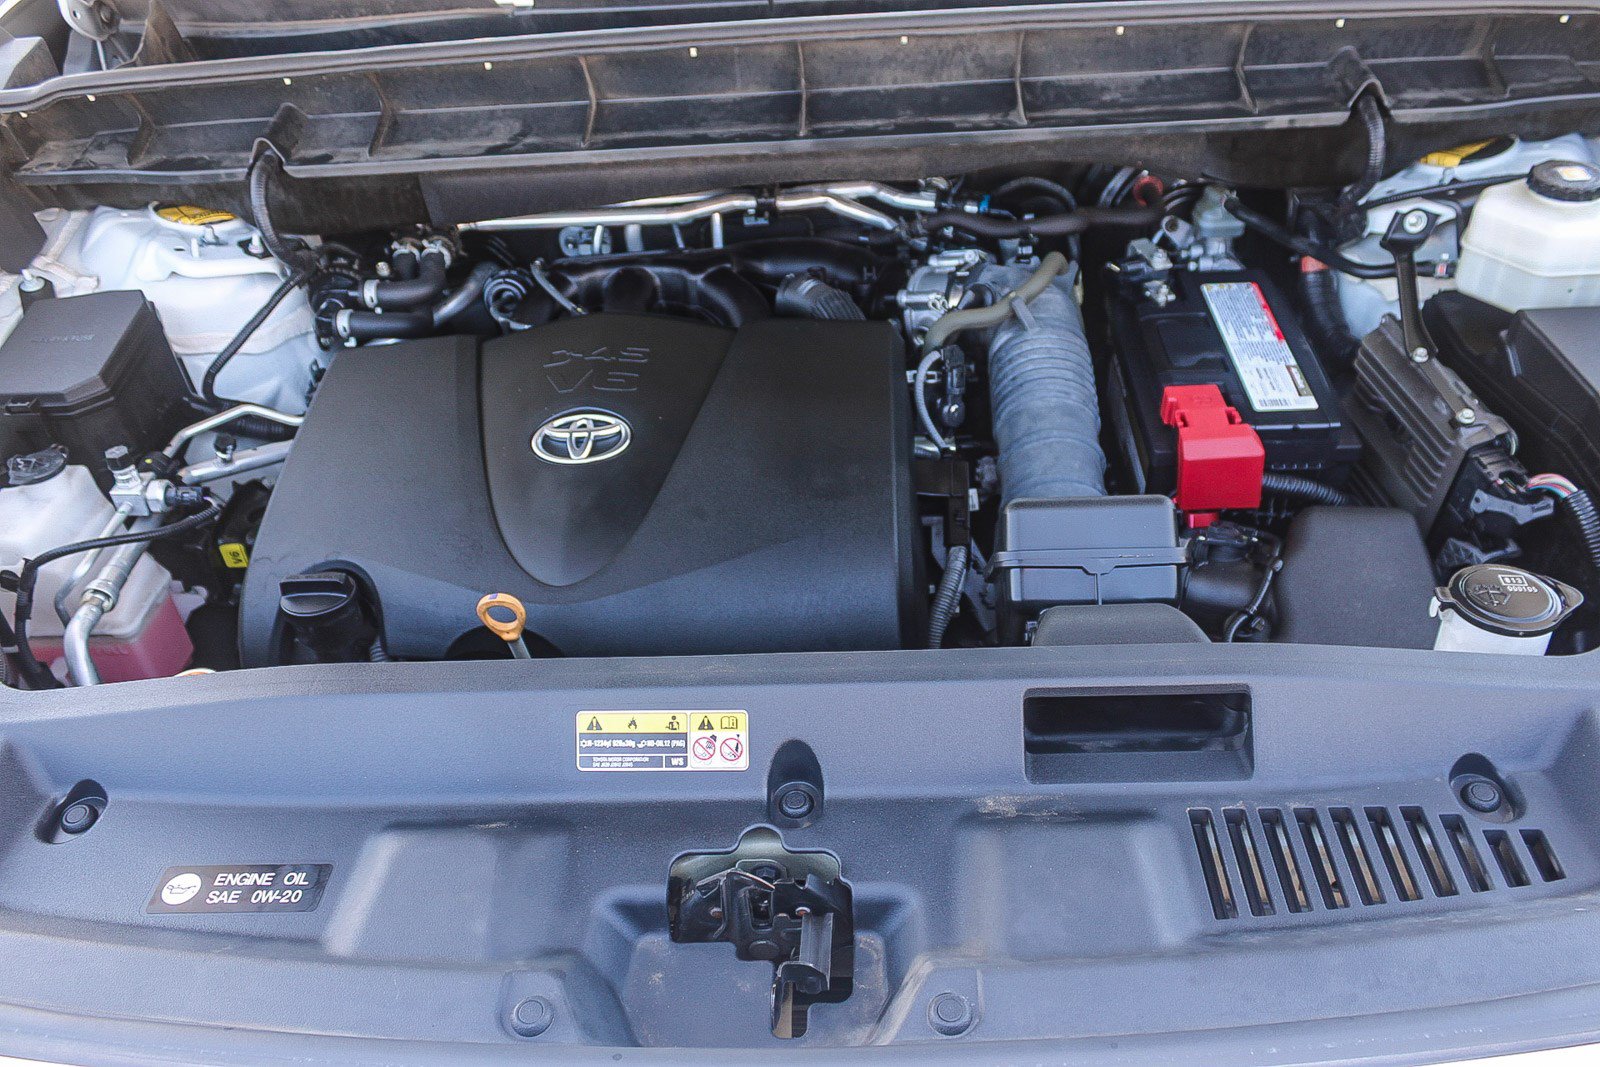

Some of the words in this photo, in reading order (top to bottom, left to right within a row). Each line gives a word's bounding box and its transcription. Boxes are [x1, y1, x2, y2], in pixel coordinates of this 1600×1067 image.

[671, 758, 684, 766] WS
[213, 872, 275, 886] ENGINE
[283, 872, 309, 885] OIL
[205, 891, 242, 904] SAE
[250, 889, 303, 903] 0W-20
